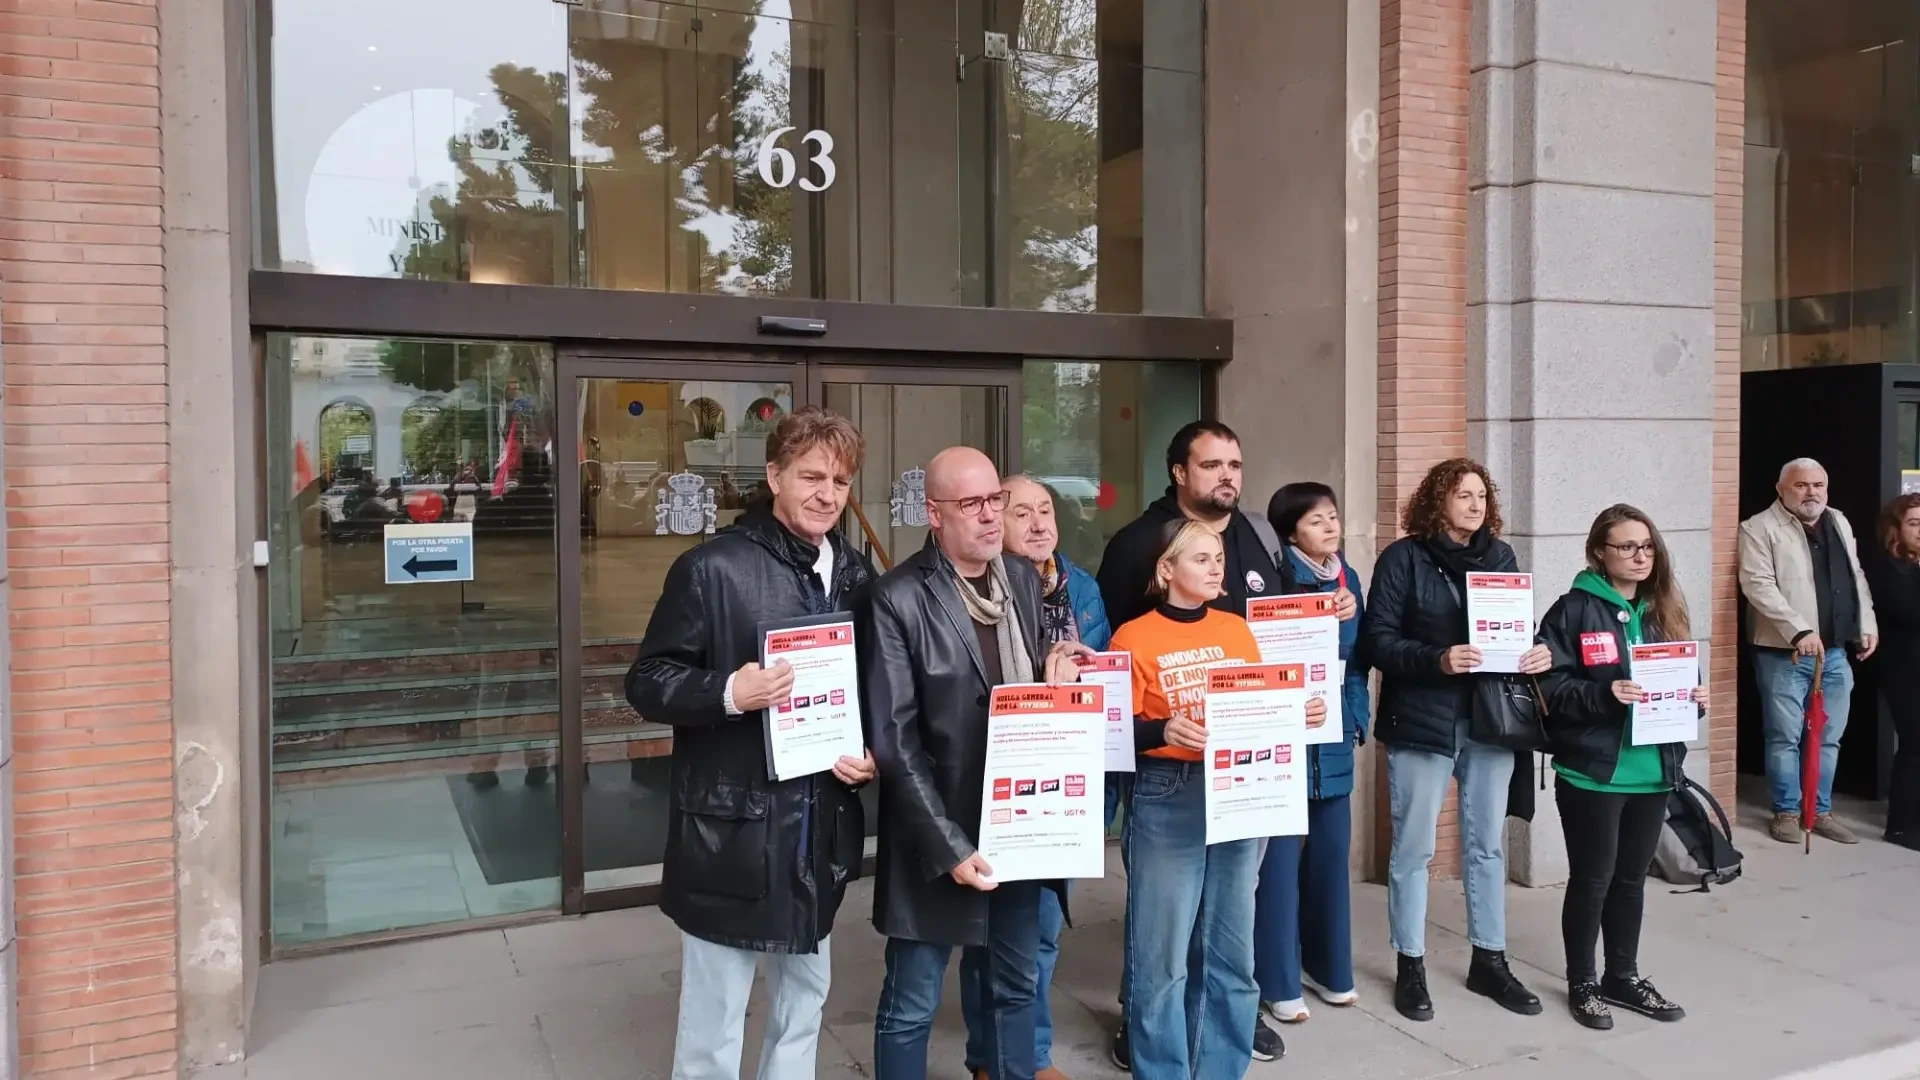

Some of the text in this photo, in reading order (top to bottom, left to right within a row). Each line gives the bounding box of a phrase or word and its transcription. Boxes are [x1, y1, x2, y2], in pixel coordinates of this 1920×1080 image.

[758, 126, 836, 192] 63
[388, 254, 402, 272] Y
[1157, 646, 1225, 668] SINDICATO
[1163, 670, 1183, 688] DE
[996, 693, 1020, 702] HUELGA
[1021, 693, 1054, 701] GENERAL
[996, 703, 1008, 711] POR
[1019, 701, 1056, 709] VIVIENDA
[1167, 691, 1177, 708] E
[1018, 783, 1034, 792] CGT
[1042, 781, 1058, 790] CNT
[1064, 809, 1079, 817] UGT
